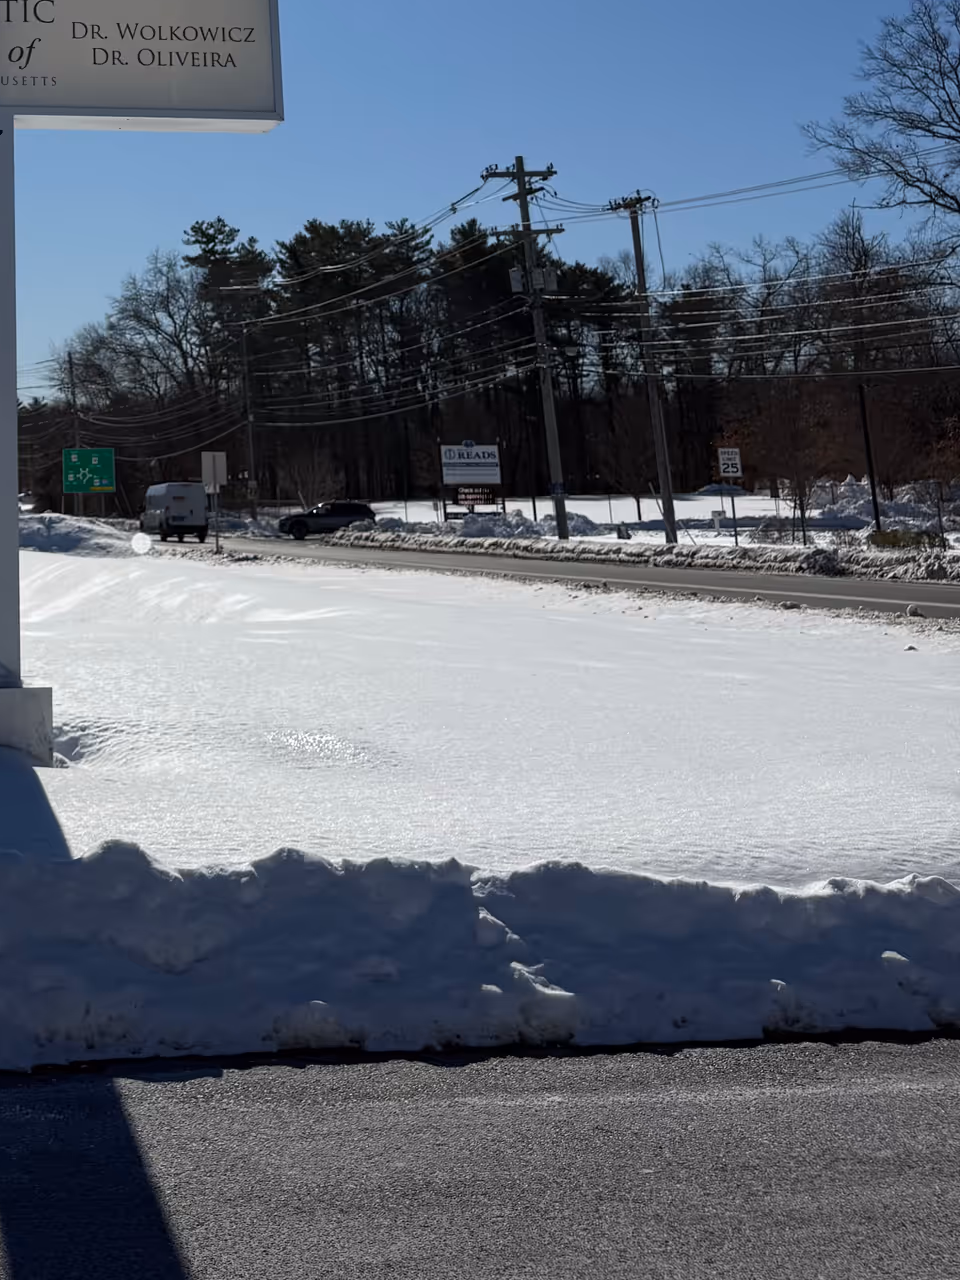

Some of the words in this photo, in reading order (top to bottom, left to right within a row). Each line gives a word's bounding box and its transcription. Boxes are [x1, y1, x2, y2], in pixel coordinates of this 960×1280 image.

[7, 37, 42, 70] of
[457, 450, 497, 460] READS
[722, 462, 739, 474] 25
